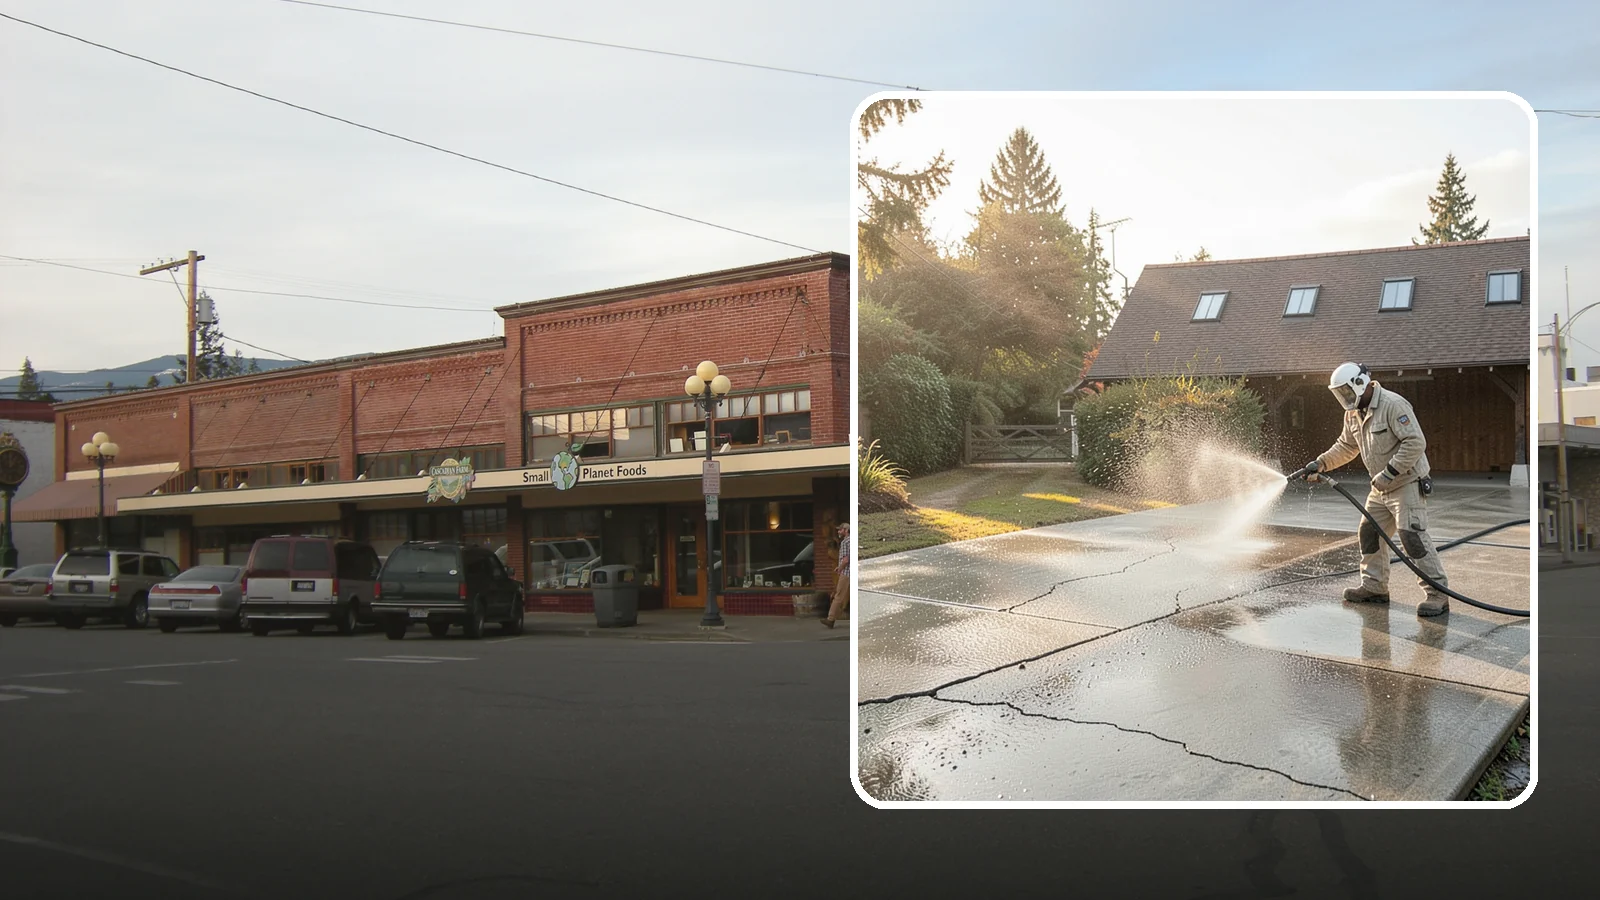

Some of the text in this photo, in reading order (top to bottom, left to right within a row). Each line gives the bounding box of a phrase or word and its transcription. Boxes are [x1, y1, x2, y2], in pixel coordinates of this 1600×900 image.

[523, 464, 647, 482] Small Planet Foods
